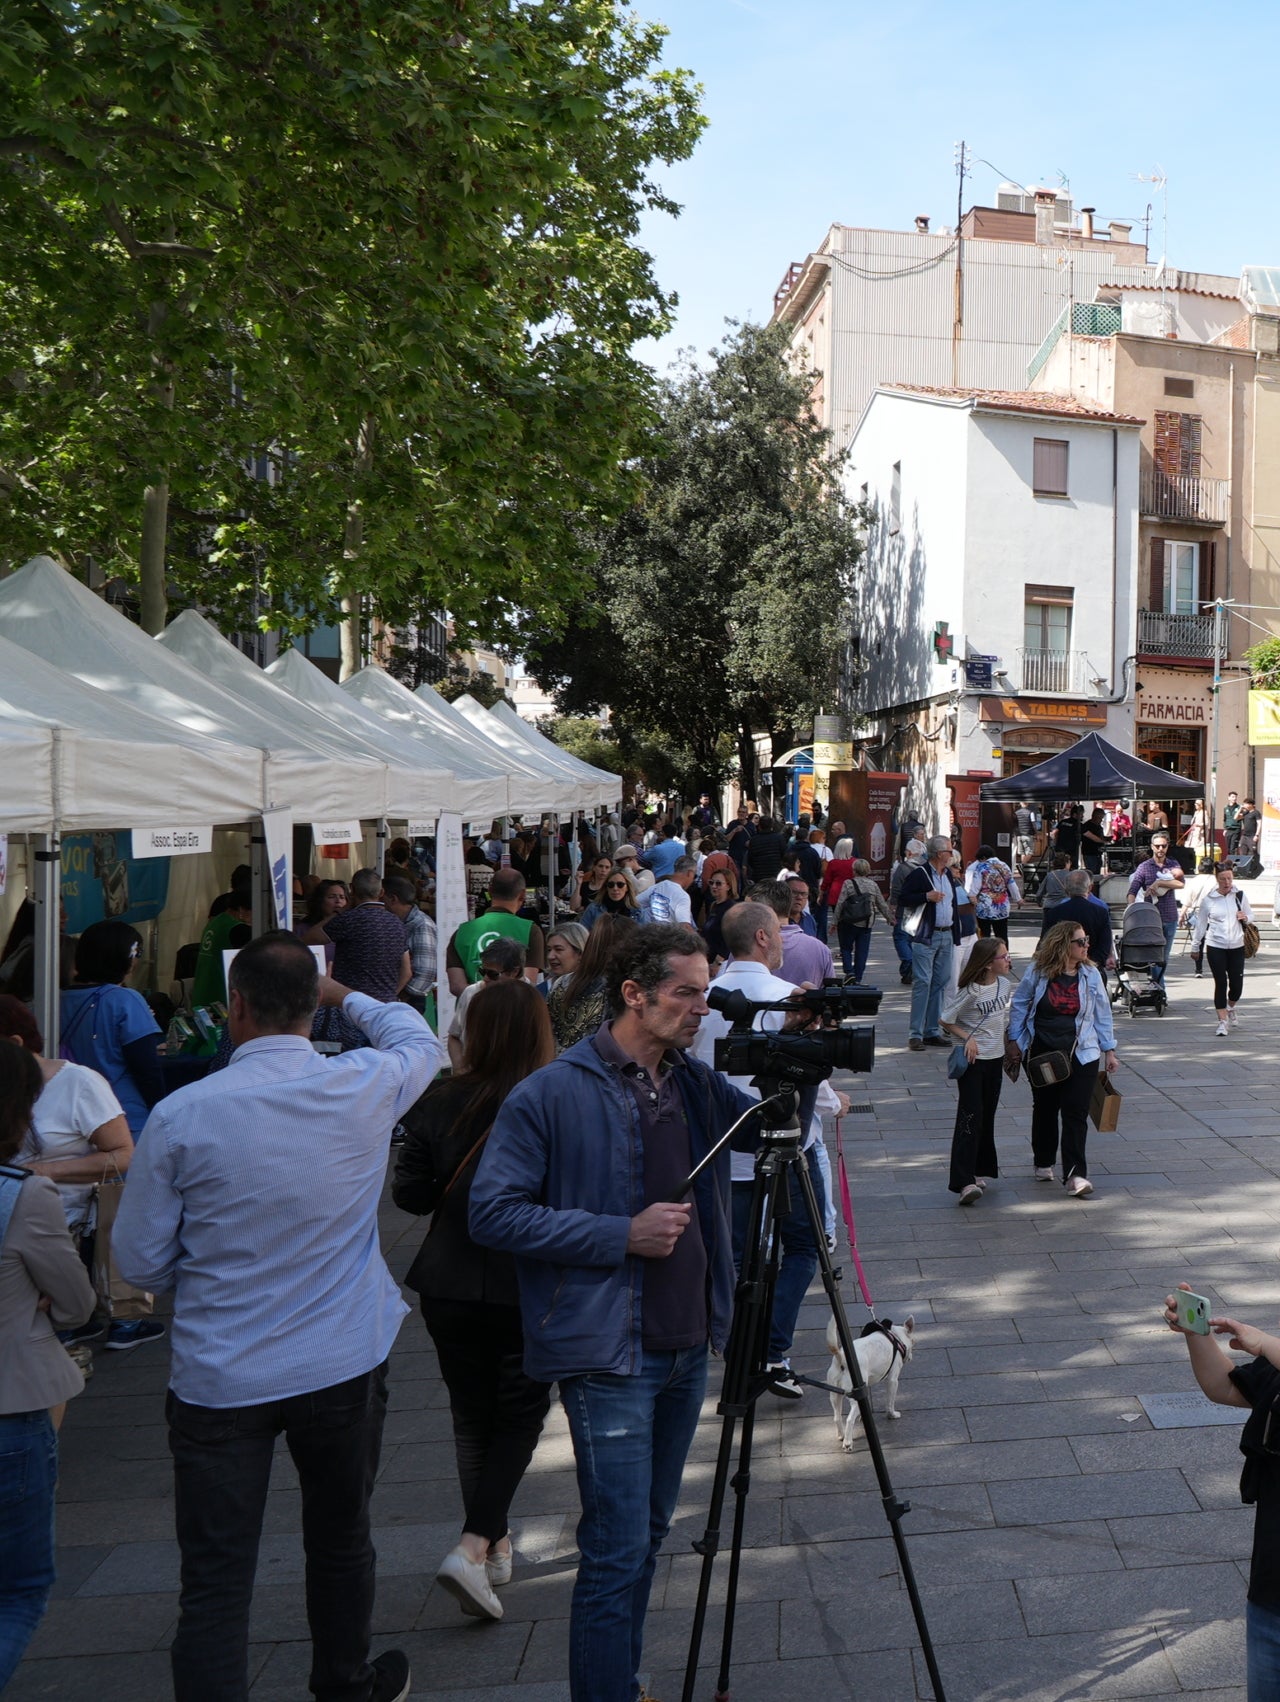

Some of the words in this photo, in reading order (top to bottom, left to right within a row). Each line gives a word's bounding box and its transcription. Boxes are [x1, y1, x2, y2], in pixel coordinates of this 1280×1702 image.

[1028, 703, 1088, 717] TABACS
[1140, 703, 1204, 721] FARMACIA
[151, 834, 171, 848] Assoc.
[173, 833, 187, 850] Espai
[786, 1065, 804, 1075] JVC
